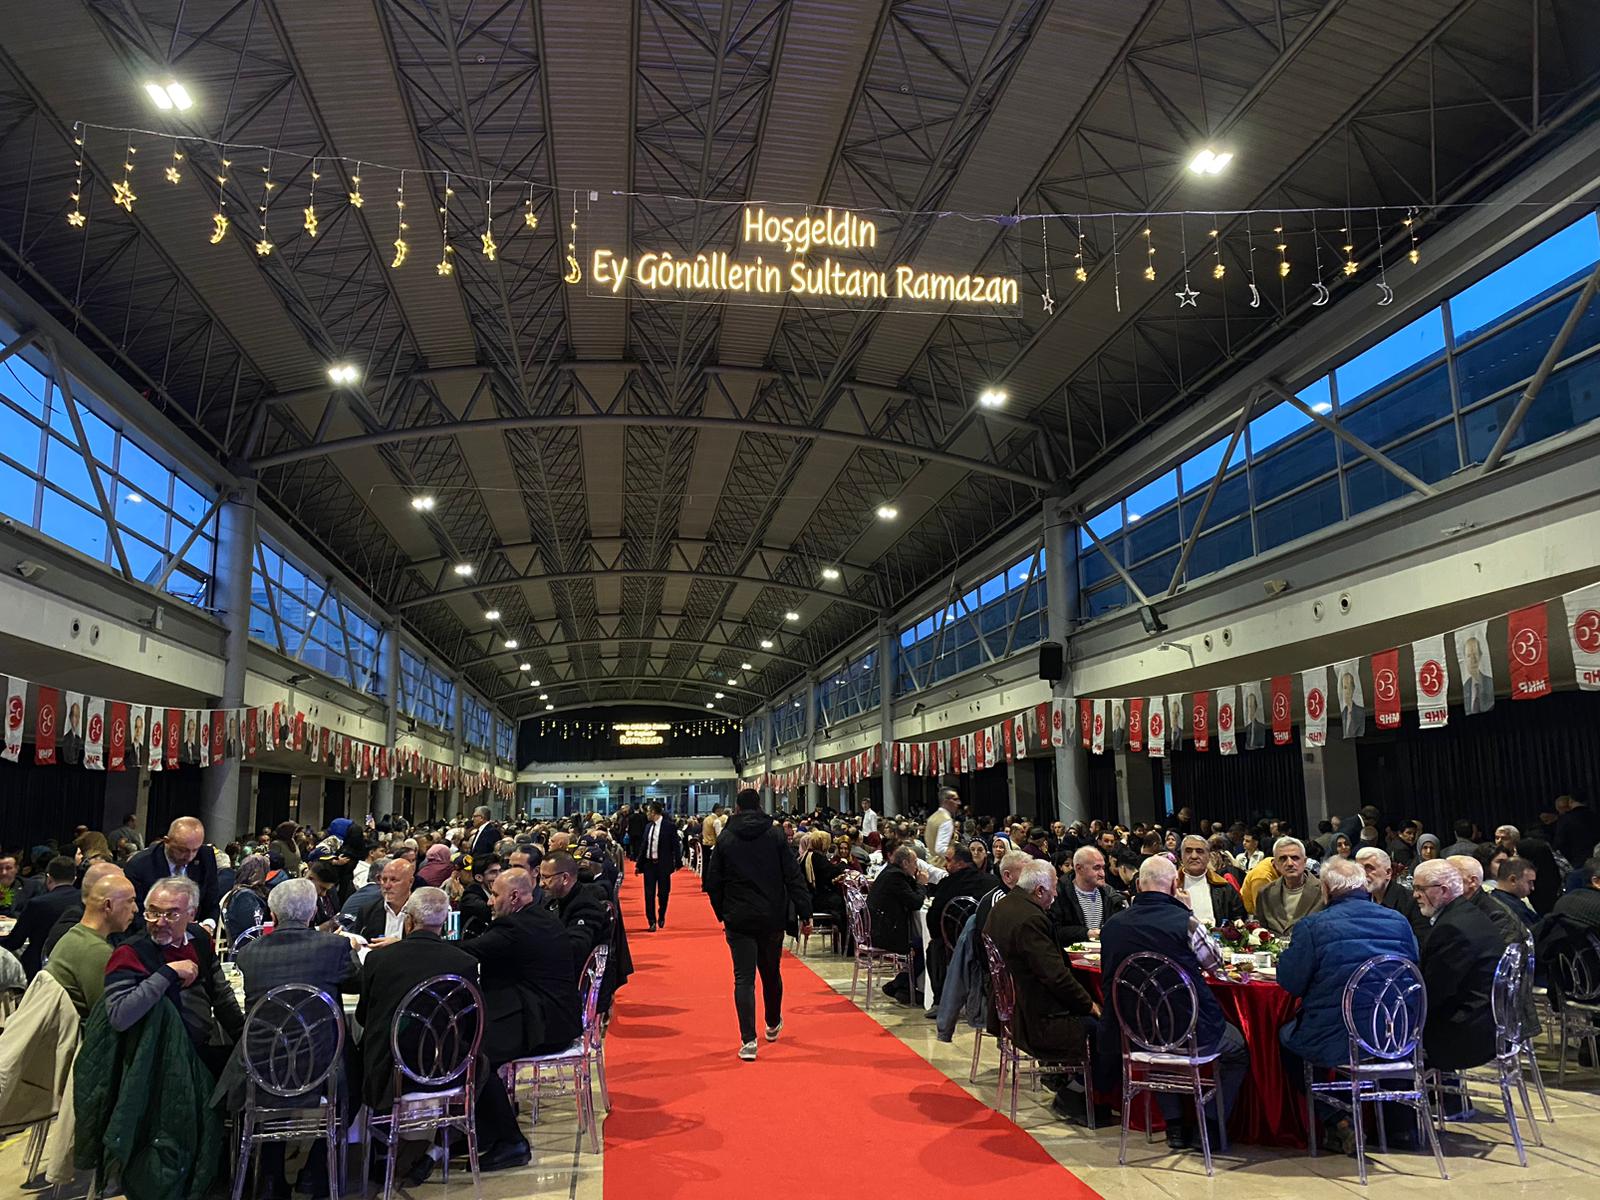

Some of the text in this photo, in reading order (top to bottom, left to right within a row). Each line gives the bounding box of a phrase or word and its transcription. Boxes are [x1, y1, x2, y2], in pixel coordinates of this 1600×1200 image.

[593, 249, 629, 292] Ey
[789, 257, 887, 298] Sultanı
[895, 265, 1018, 304] Ramazan
[619, 734, 664, 745] Ramazan
